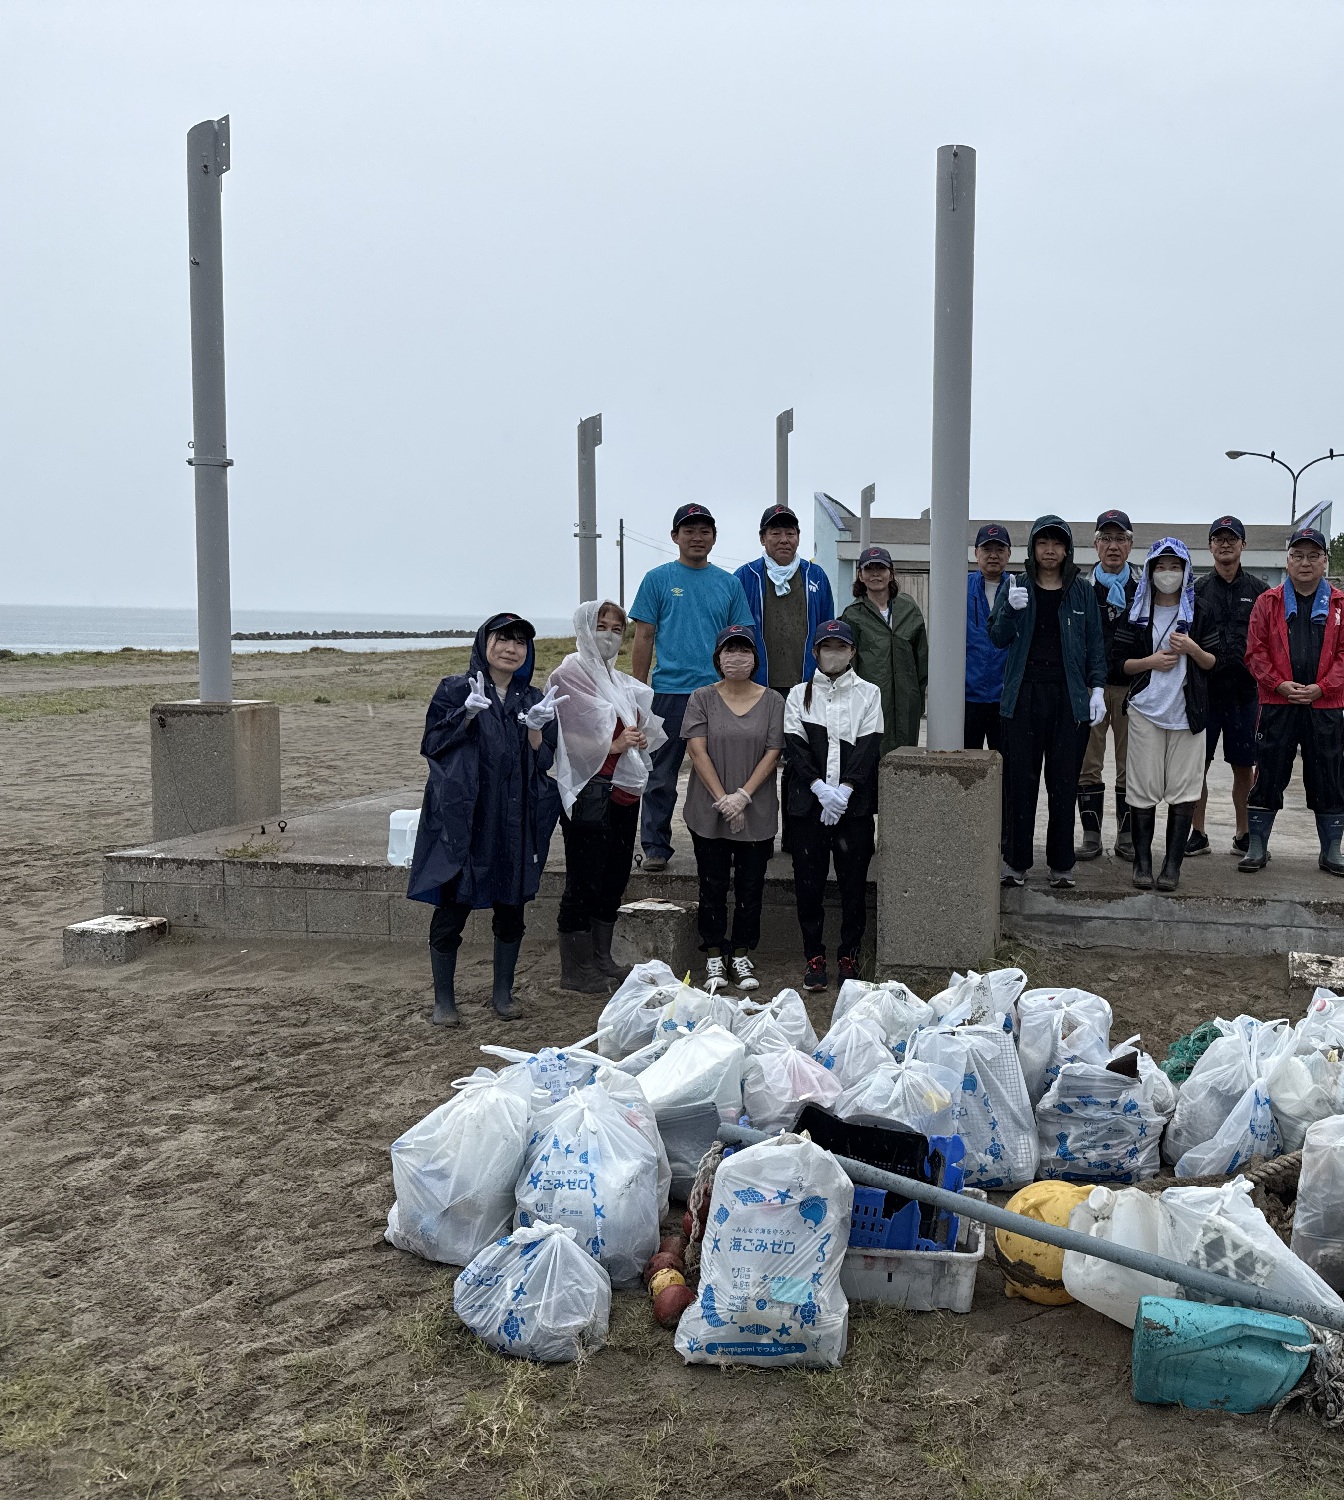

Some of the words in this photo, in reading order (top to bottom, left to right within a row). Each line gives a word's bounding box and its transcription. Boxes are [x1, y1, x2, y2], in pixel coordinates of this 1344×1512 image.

[729, 1236, 796, 1254] 海ごみゼロ
